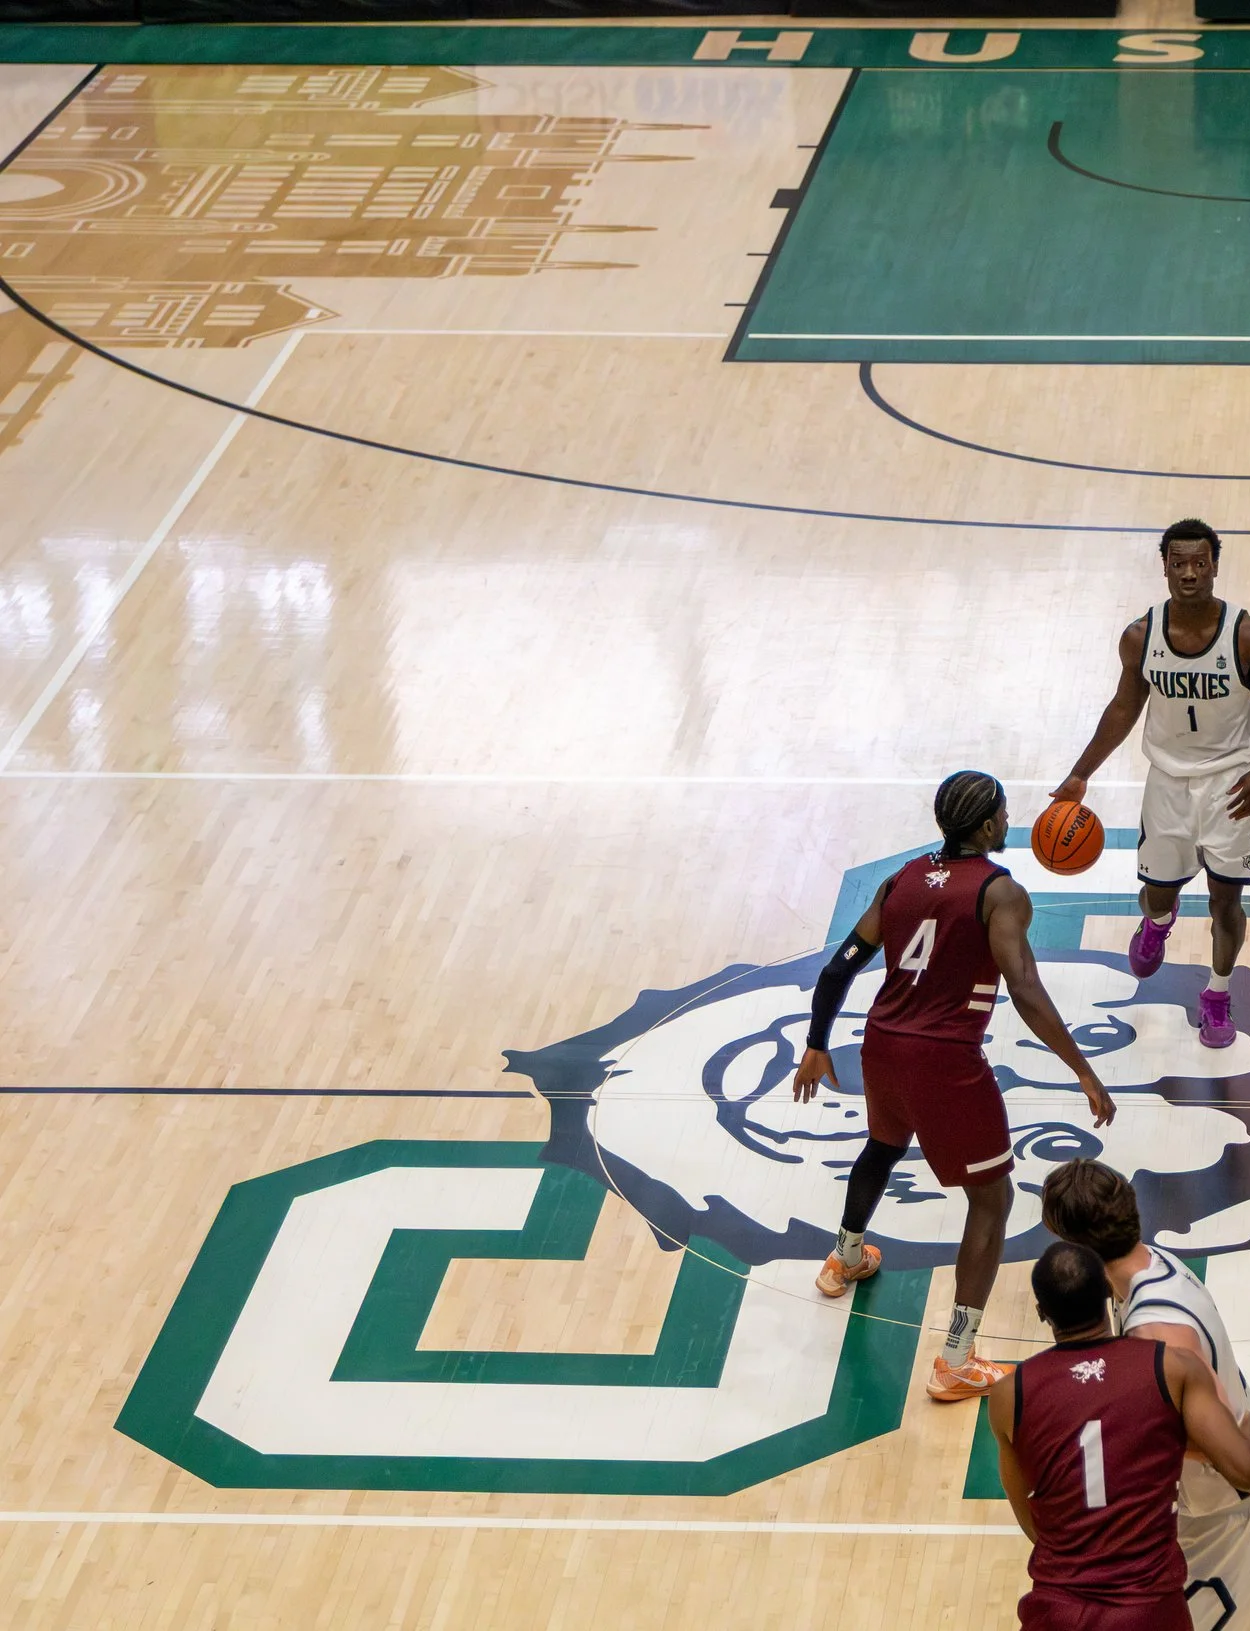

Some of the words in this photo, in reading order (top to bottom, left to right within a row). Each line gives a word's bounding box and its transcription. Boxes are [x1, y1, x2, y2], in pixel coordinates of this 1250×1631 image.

[1149, 669, 1231, 700] HUSKIES
[1187, 705, 1198, 732] 1
[1061, 807, 1091, 847] Wilson
[899, 919, 938, 986] 4
[1079, 1419, 1108, 1509] 1
